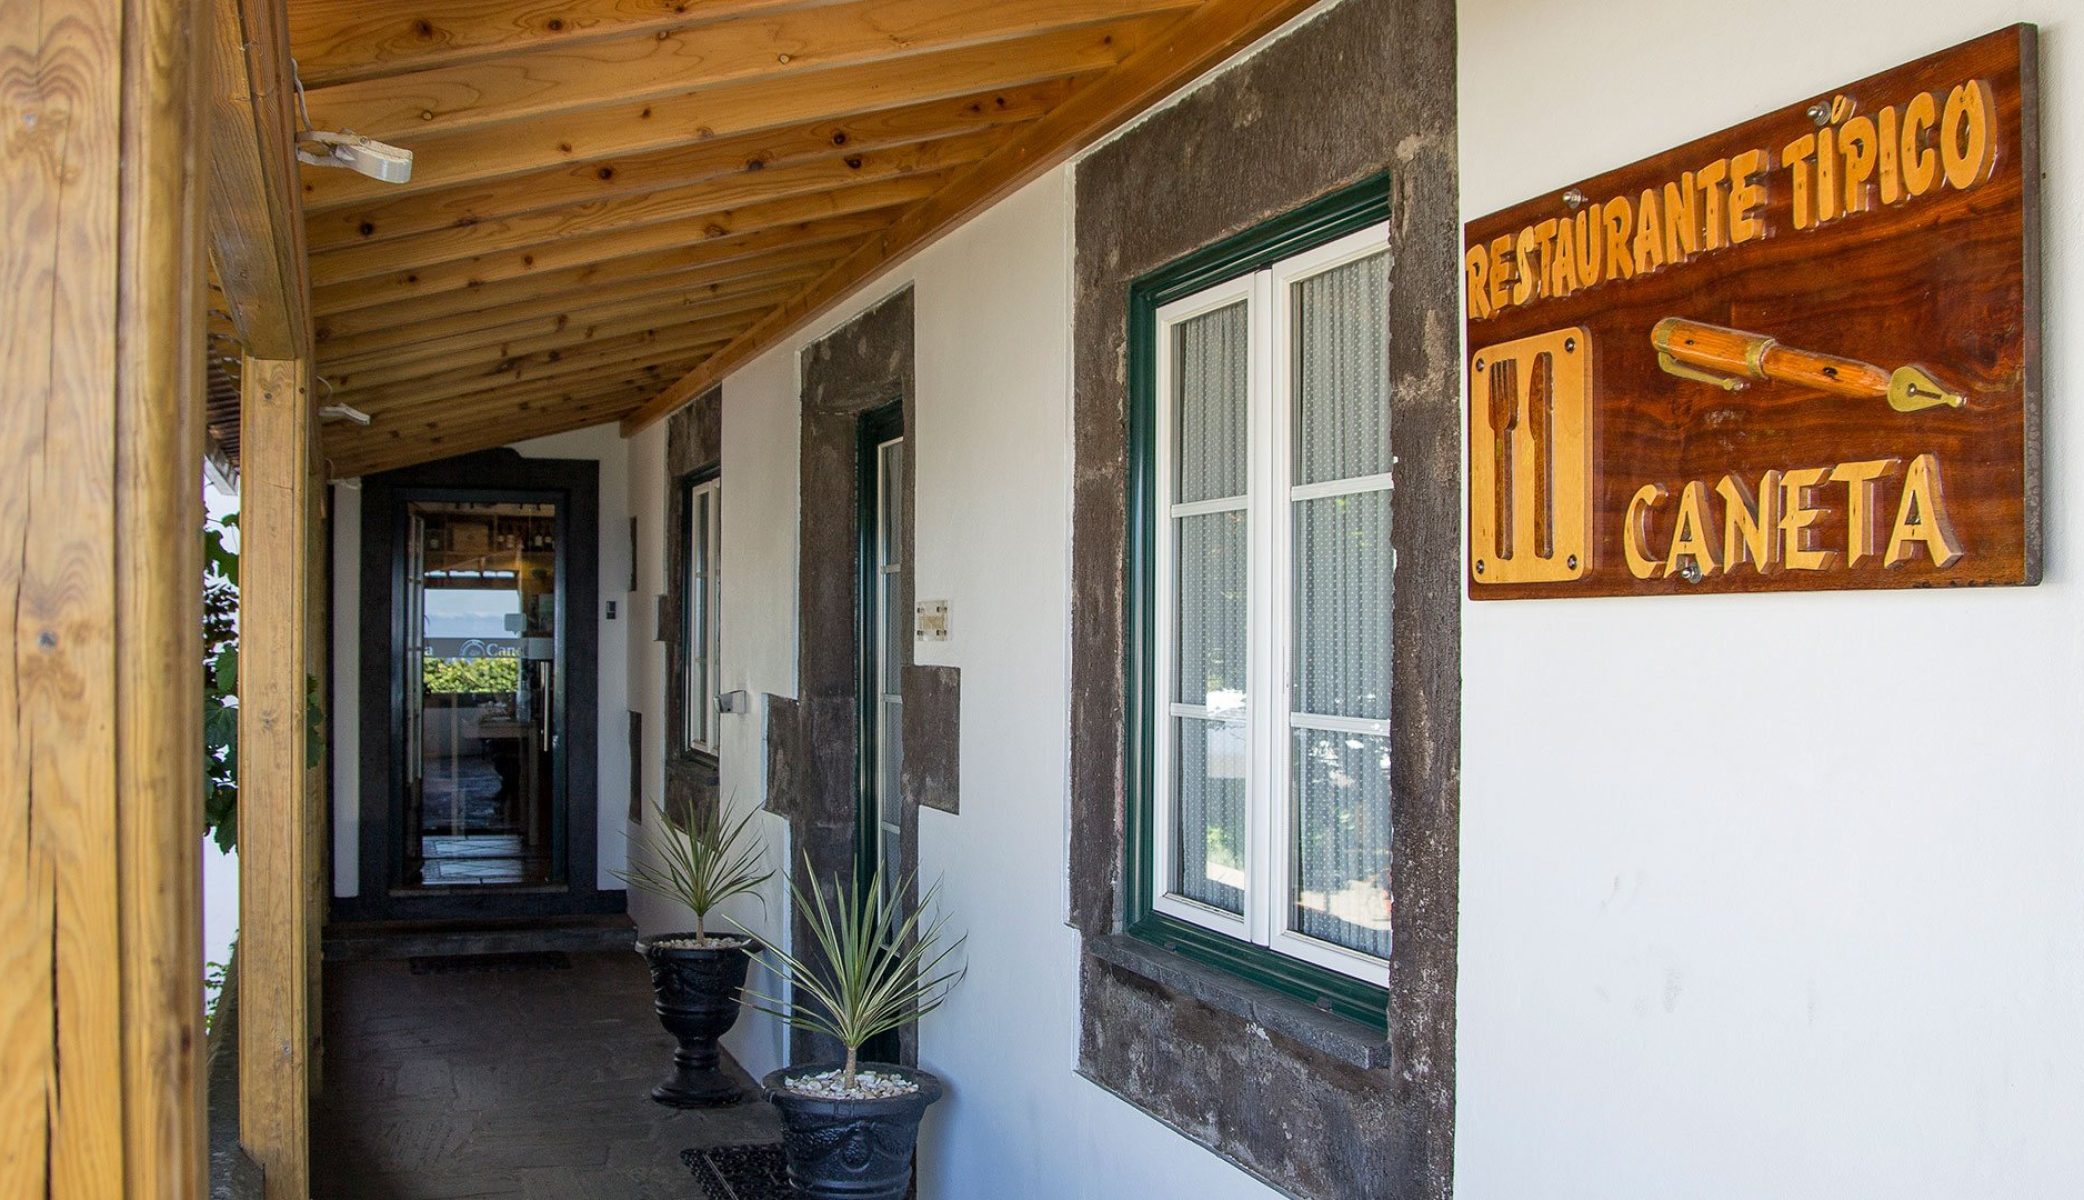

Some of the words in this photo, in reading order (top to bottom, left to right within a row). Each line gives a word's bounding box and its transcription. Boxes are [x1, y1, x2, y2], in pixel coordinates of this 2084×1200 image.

[1465, 149, 1768, 319] RESTAURANTE
[1782, 79, 1995, 230] TÍPICO
[1624, 454, 1963, 579] CANETA
